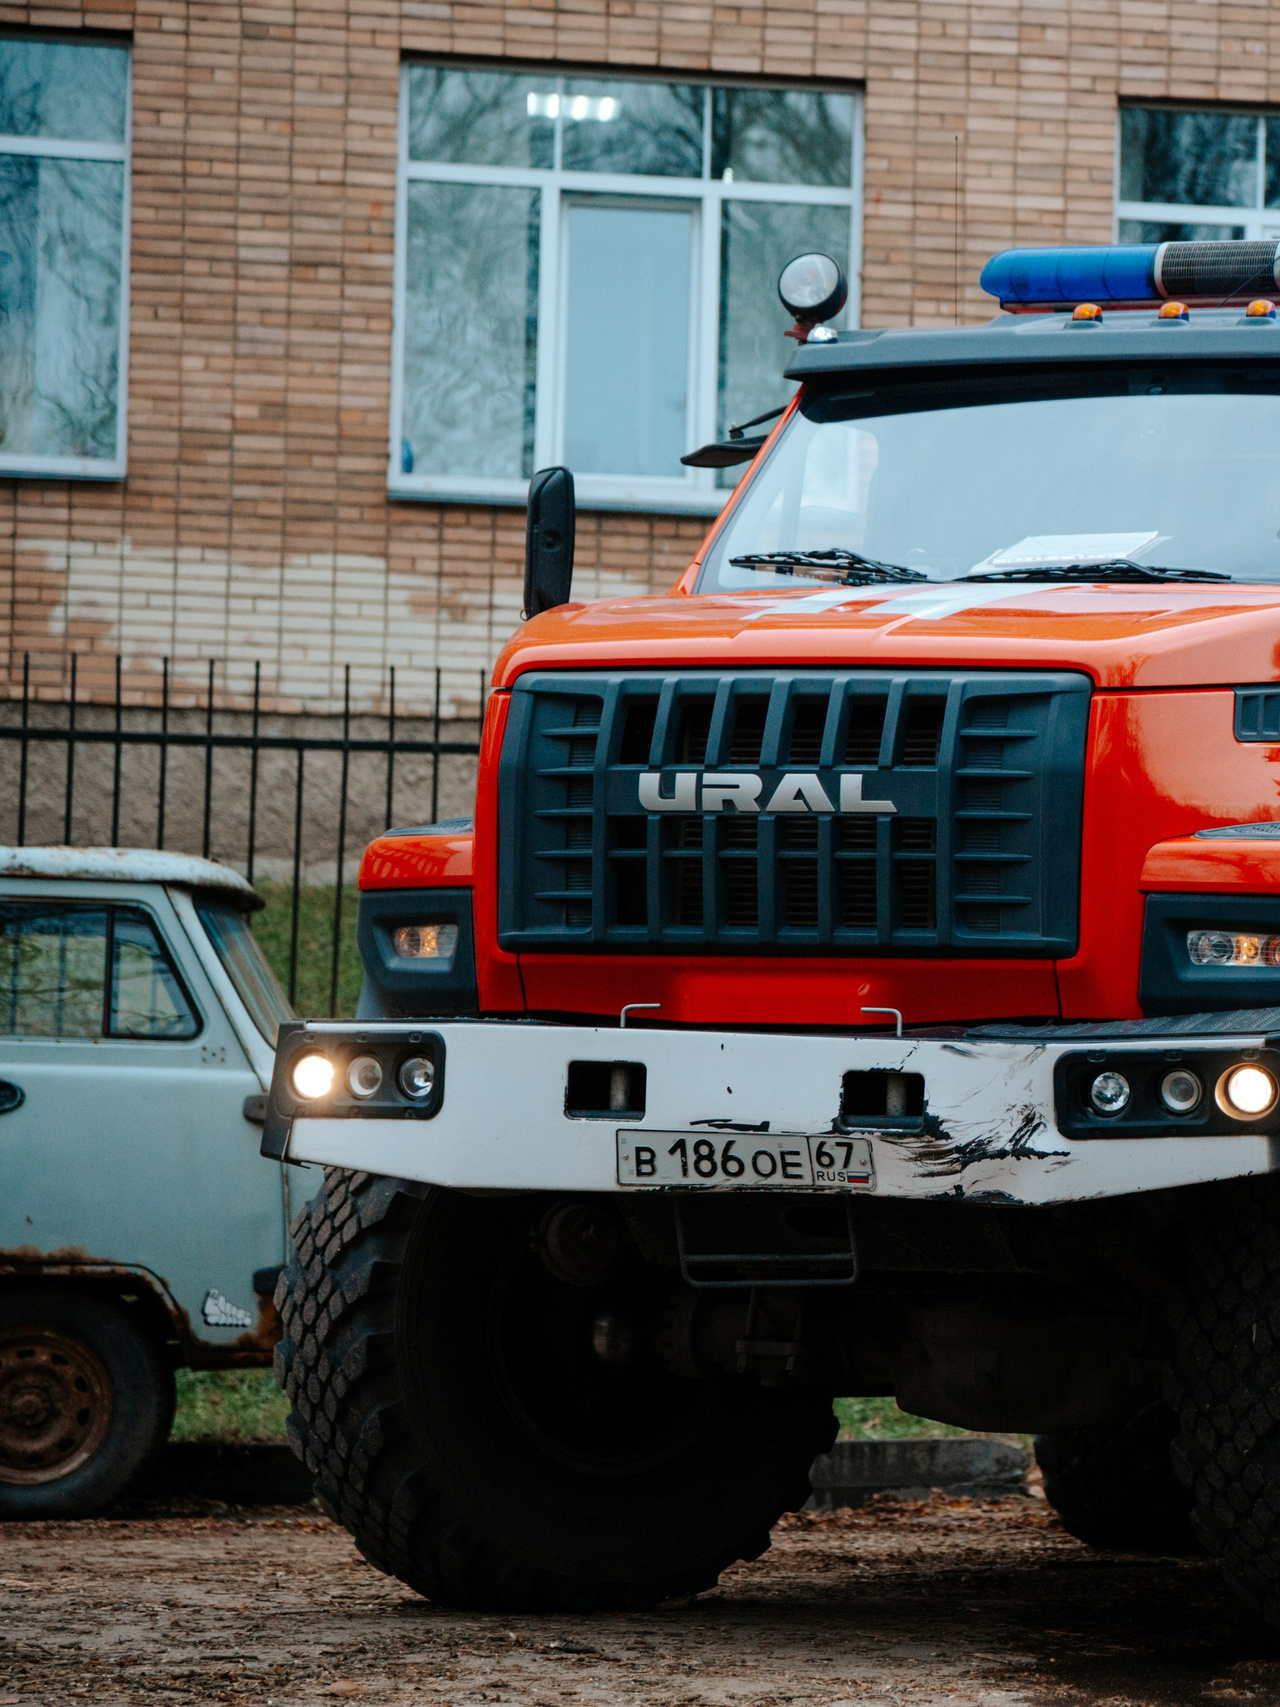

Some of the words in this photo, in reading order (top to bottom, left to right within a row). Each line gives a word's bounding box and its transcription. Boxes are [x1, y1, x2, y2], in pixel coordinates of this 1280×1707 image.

[638, 772, 898, 813] URAL
[815, 1140, 854, 1169] 67
[816, 1171, 846, 1182] RUS
